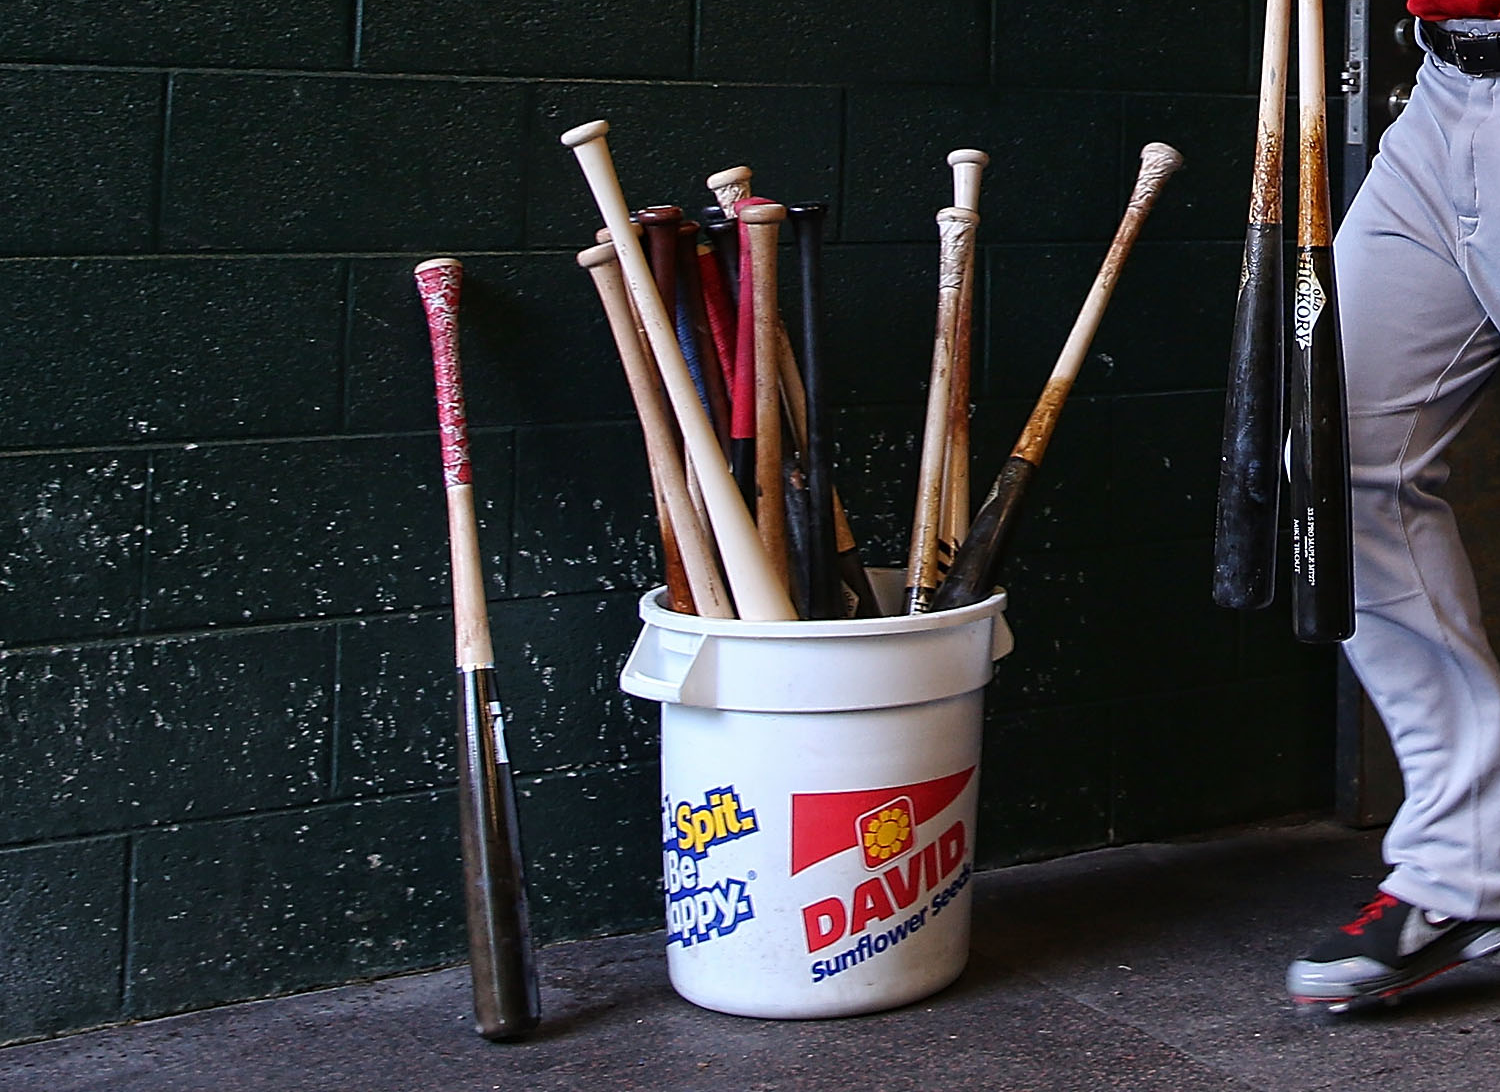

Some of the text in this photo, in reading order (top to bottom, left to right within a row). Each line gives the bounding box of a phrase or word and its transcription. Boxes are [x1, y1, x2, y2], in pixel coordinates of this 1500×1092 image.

[1297, 257, 1311, 344] HICKORY
[1312, 288, 1323, 312] OLD
[1307, 522, 1315, 538] PRO
[676, 793, 755, 854] Spit.
[664, 850, 697, 894] Be
[803, 820, 966, 954] DAVID
[665, 882, 749, 939] appy.
[811, 906, 928, 984] sunflower
